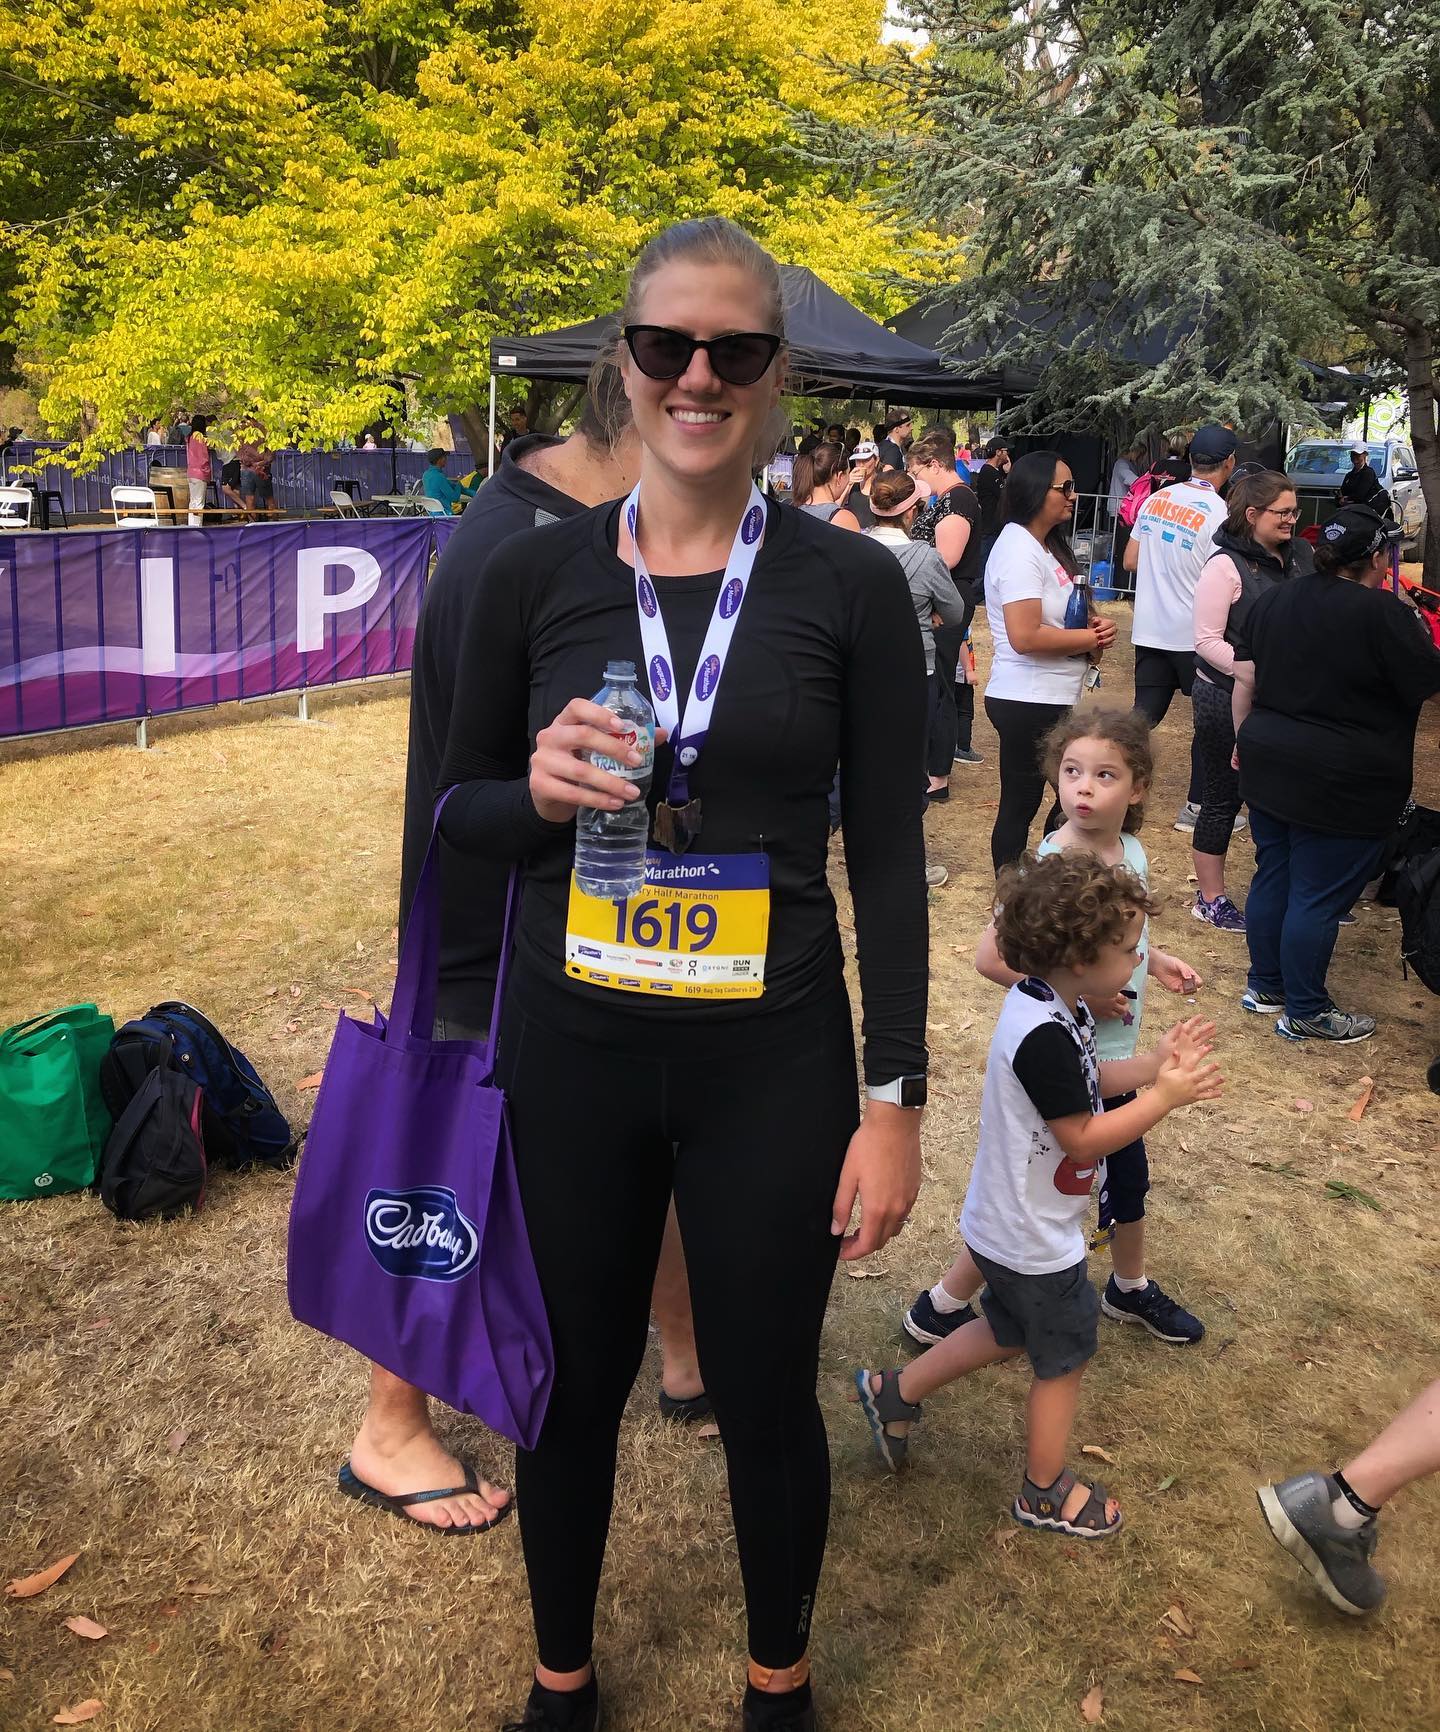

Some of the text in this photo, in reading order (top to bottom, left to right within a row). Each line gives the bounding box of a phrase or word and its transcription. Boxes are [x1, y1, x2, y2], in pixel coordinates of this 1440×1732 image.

[1142, 498, 1206, 533] FINISHER
[655, 662, 668, 688] Marathon
[703, 667, 711, 693] Marathon
[644, 865, 706, 880] Marathon
[653, 888, 672, 898] Half
[675, 890, 719, 901] Marathon
[612, 899, 718, 952] 1619
[685, 985, 701, 994] 1619
[366, 1199, 462, 1265] Cadbury
